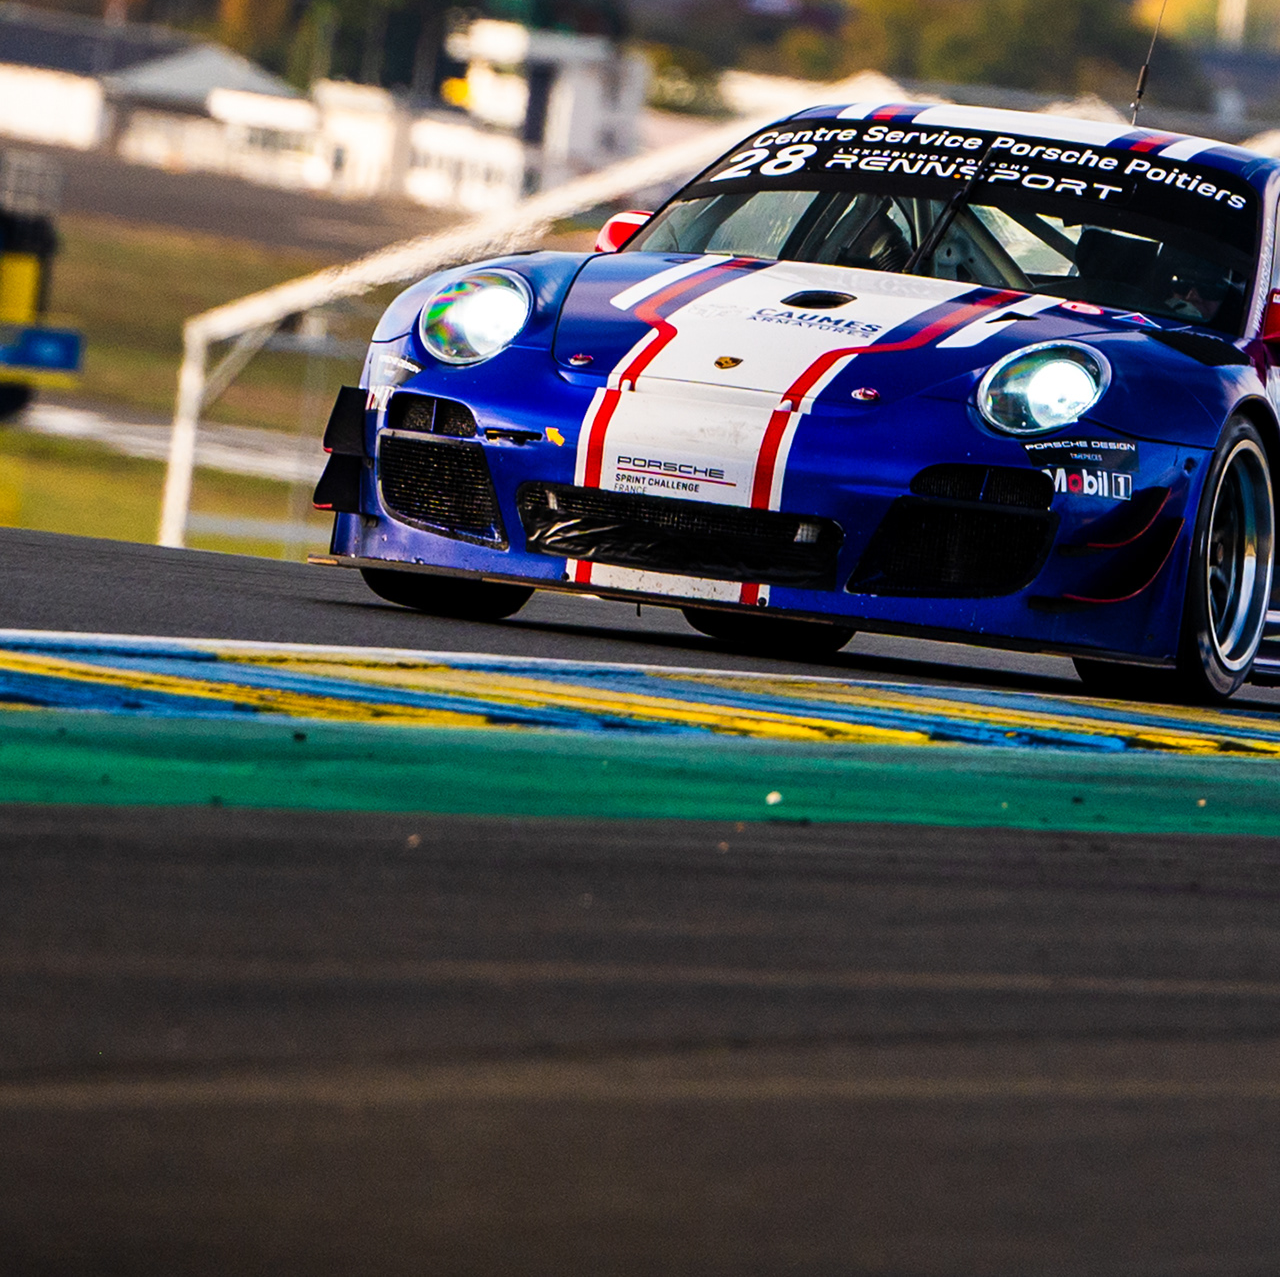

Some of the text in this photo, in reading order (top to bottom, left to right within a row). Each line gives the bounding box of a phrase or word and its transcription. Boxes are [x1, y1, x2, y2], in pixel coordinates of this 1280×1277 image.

[709, 143, 818, 183] 28
[752, 126, 1248, 210] Centre Service Porsche Poitiers
[746, 315, 875, 340] ARMATURES
[755, 308, 883, 333] CAUMES
[1024, 440, 1136, 452] PORSCHE DESIGN
[616, 455, 725, 480] PORSCHE
[613, 482, 648, 495] FRANCE
[615, 473, 700, 493] SPRINT CHALLENGE
[1041, 467, 1109, 498] Mobil
